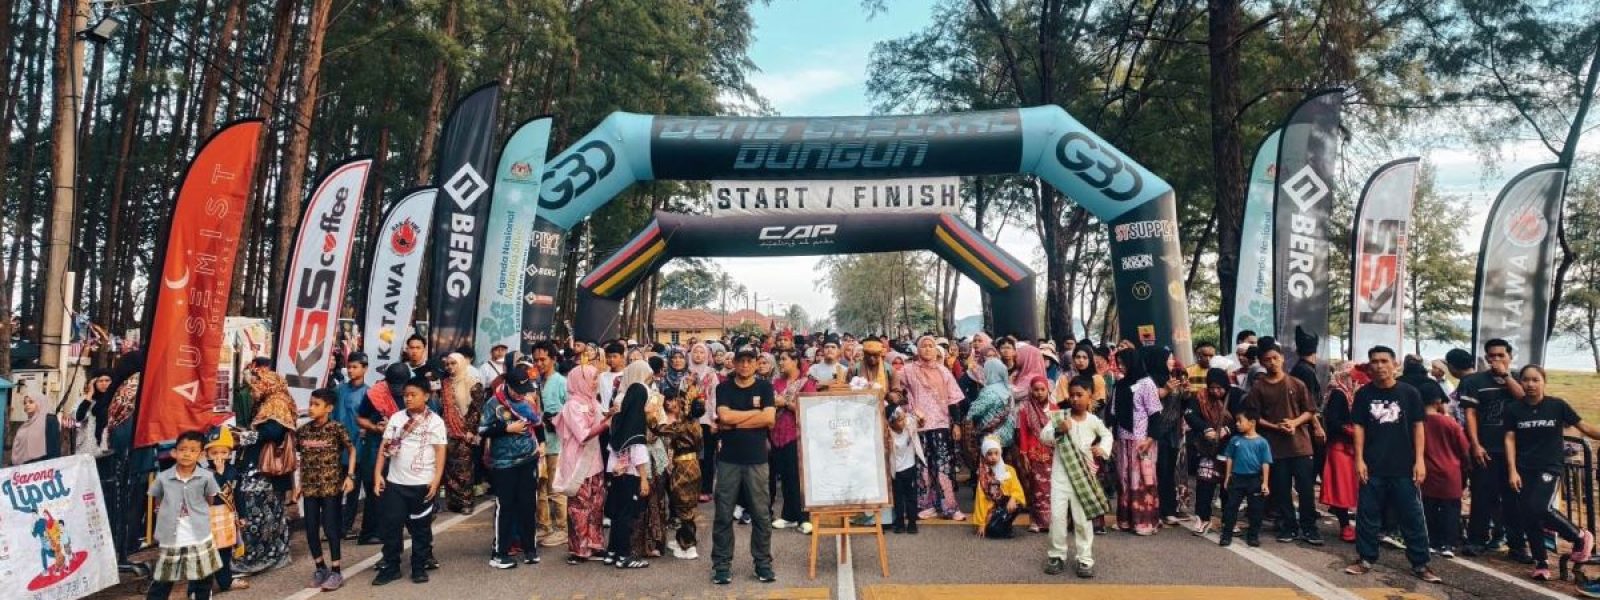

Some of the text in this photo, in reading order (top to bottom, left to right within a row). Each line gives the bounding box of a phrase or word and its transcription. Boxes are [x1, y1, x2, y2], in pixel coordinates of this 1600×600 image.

[733, 139, 928, 169] DUNGUN
[717, 186, 809, 210] START
[854, 184, 957, 208] FINISH
[759, 224, 837, 240] CAP
[1259, 212, 1272, 253] Naional
[446, 212, 475, 299] BERG
[1287, 213, 1316, 298] BERG
[2, 469, 71, 513] Lipat
